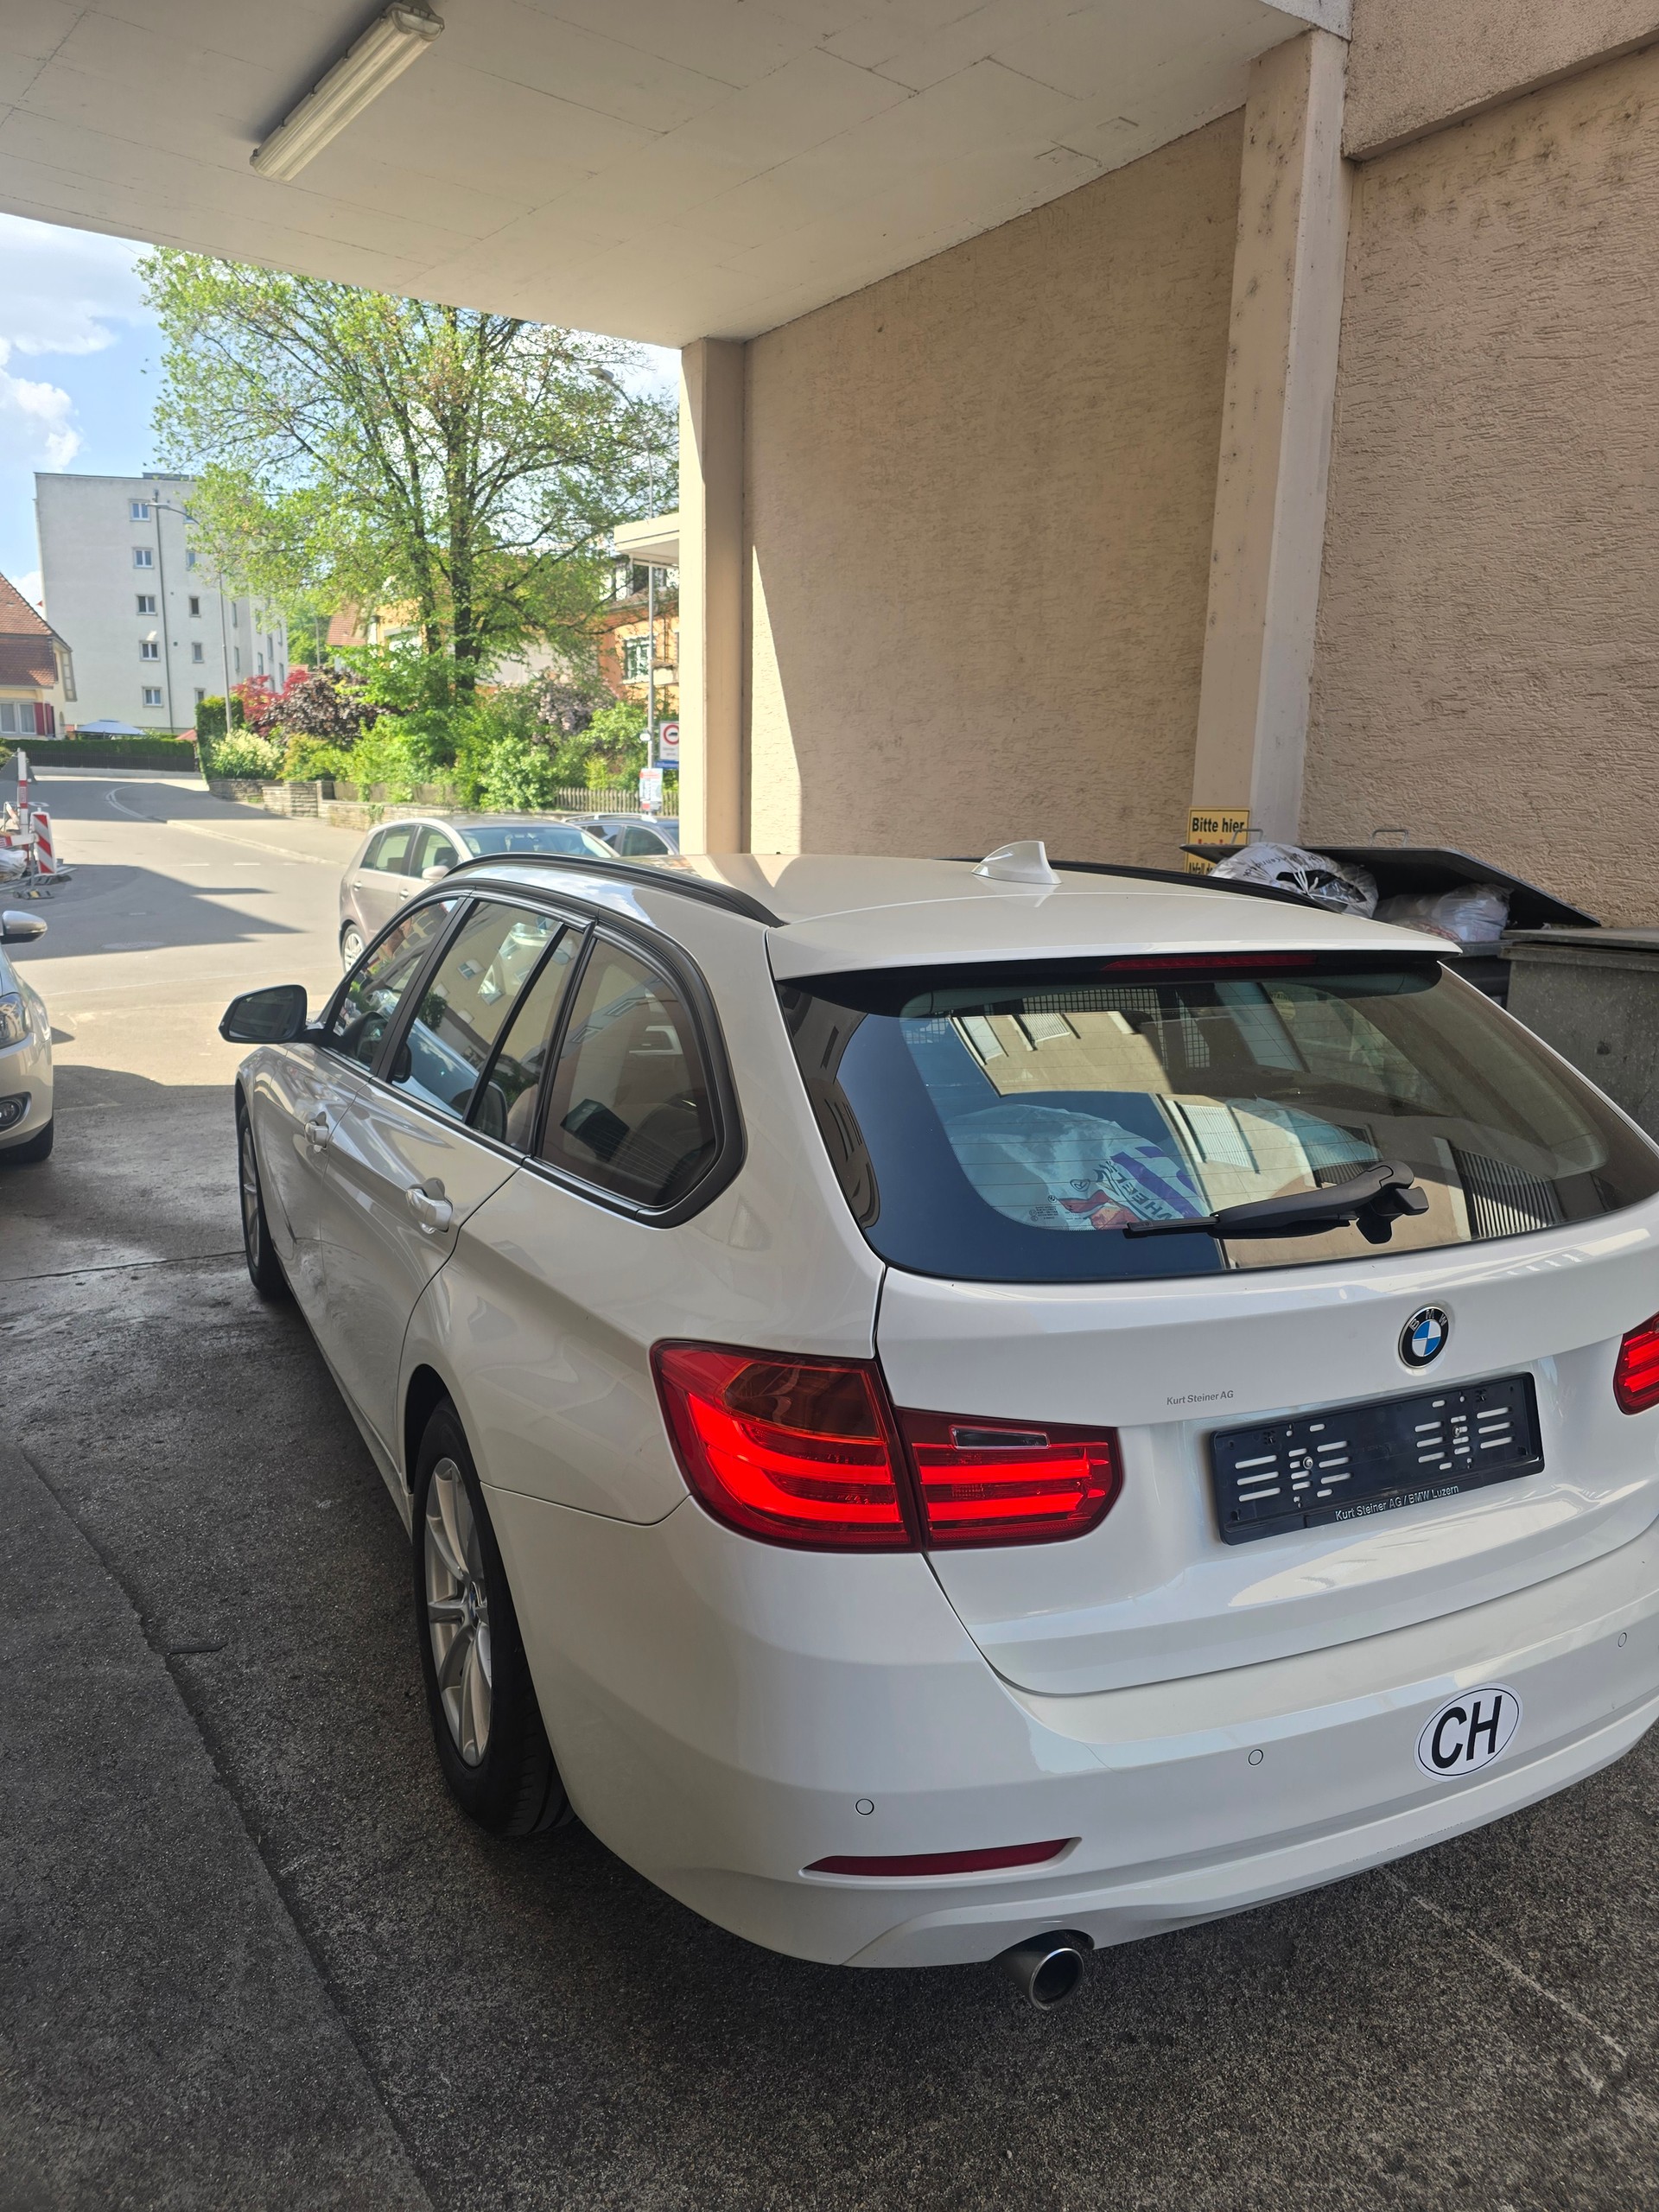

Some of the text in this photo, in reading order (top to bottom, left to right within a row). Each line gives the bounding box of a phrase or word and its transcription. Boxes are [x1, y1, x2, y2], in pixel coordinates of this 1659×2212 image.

[1192, 817, 1244, 833] Bitte hier
[1409, 1308, 1447, 1332] BMW
[1166, 1390, 1234, 1405] Kurt Steiner AG
[1335, 1508, 1355, 1521] Kurt
[1357, 1502, 1387, 1516] Steiner
[1389, 1497, 1402, 1509] AG
[1409, 1490, 1432, 1503] BMW
[1432, 1485, 1459, 1498] Luzern
[1432, 1694, 1503, 1769] CH
